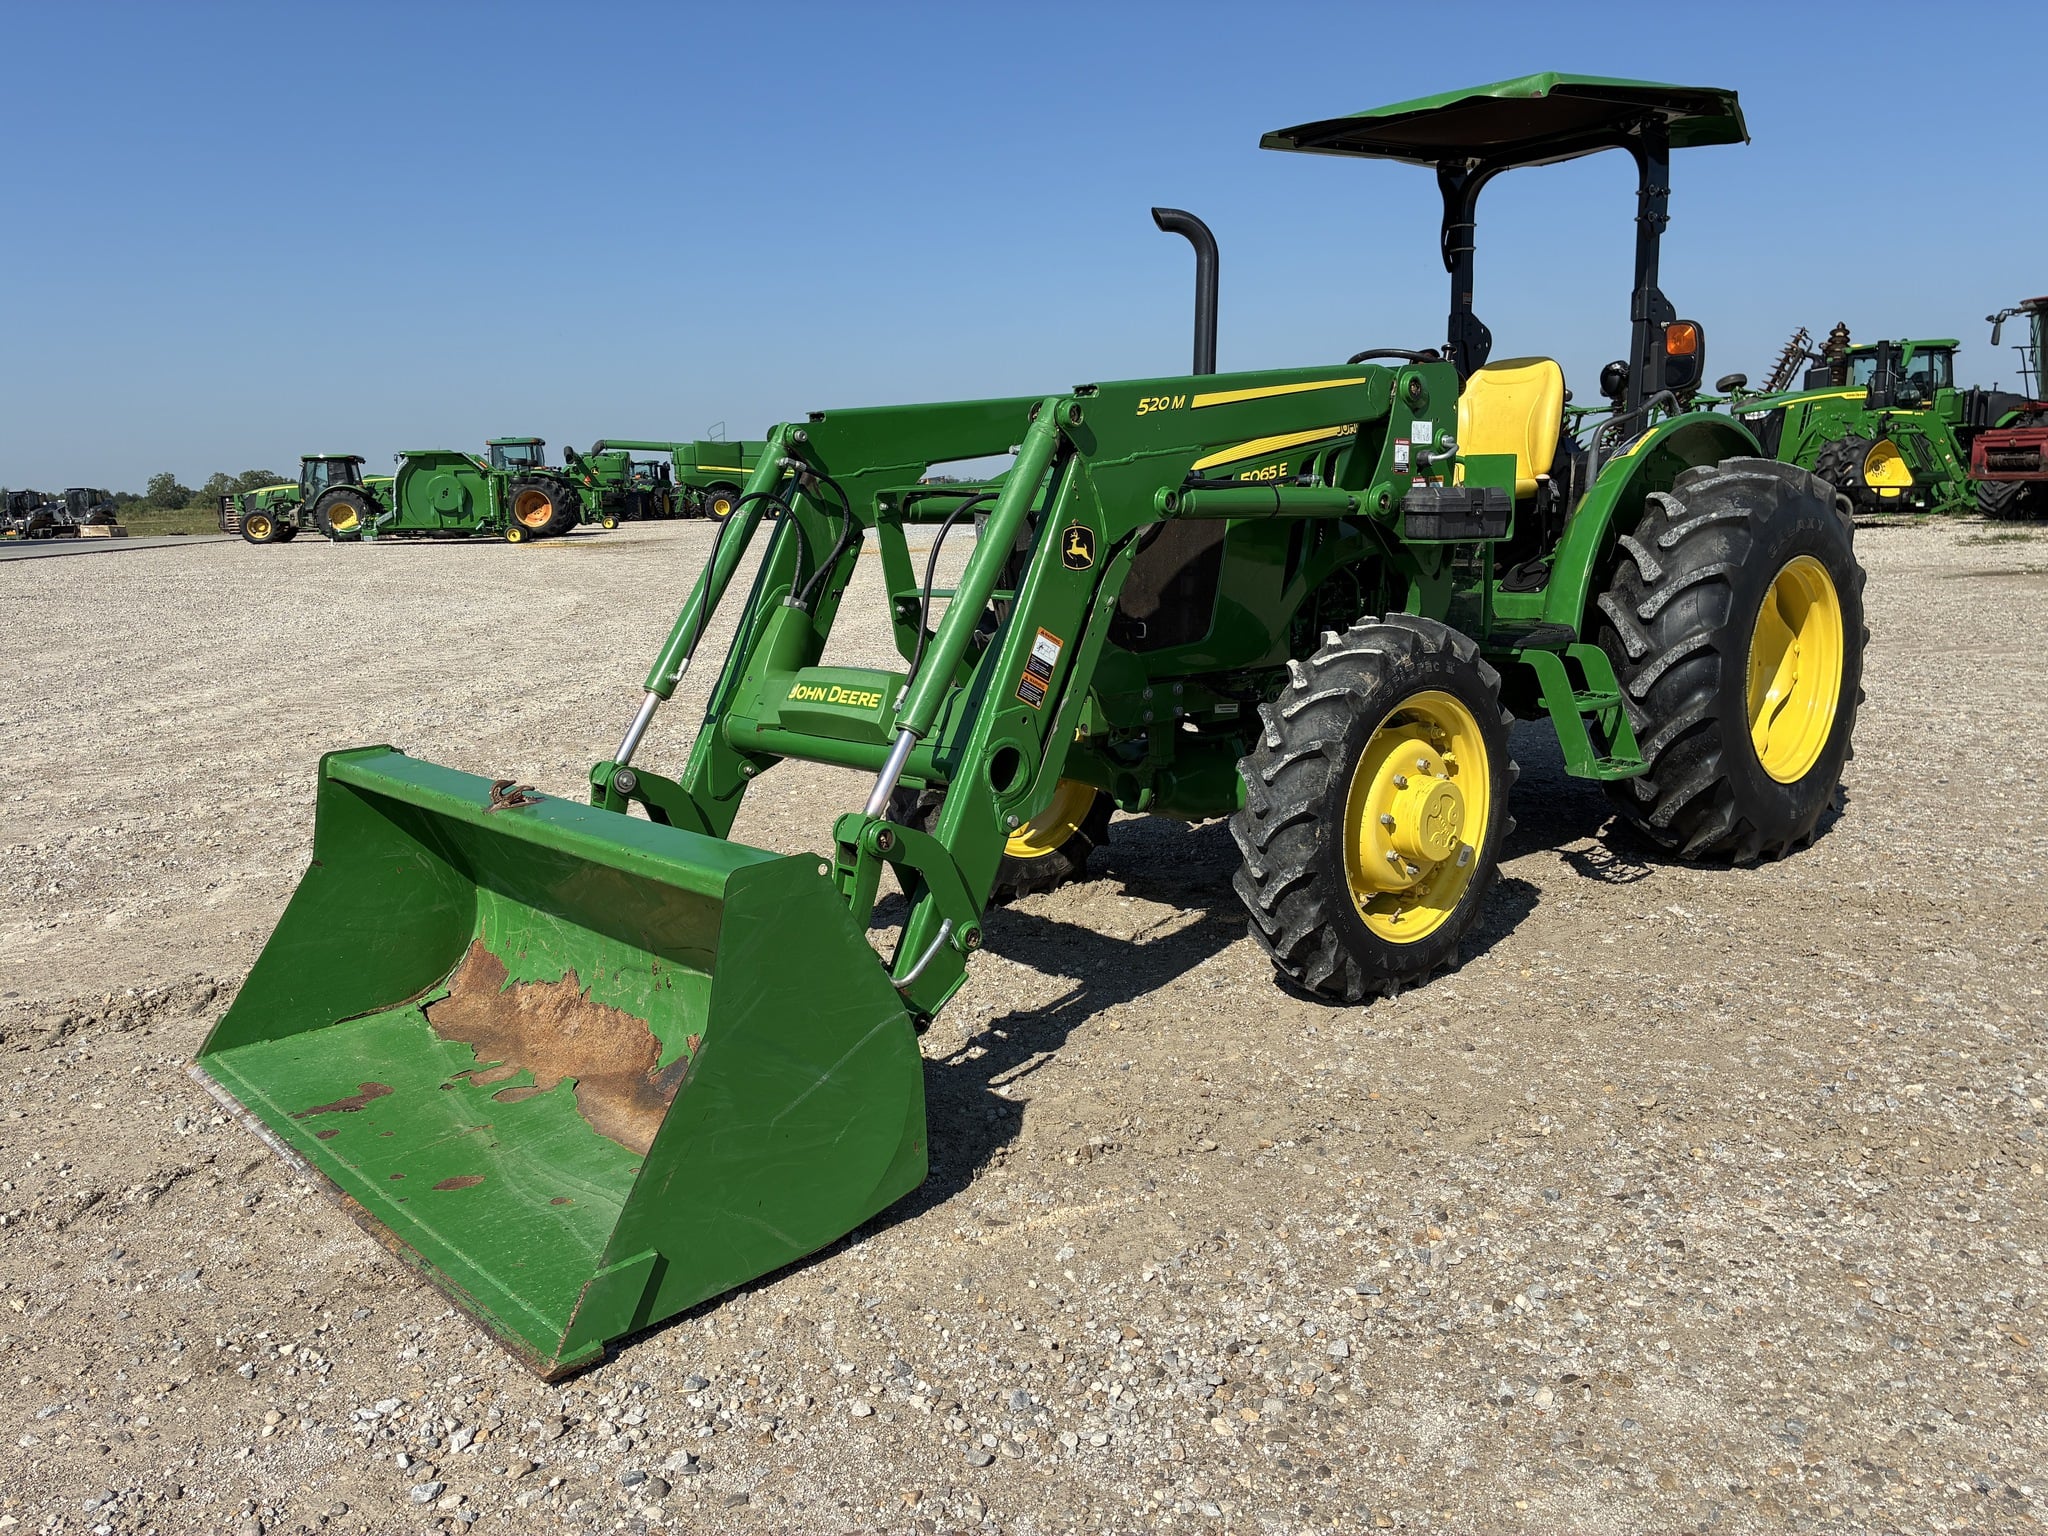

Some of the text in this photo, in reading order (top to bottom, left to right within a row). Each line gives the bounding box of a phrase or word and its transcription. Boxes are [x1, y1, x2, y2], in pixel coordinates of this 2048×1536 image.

[1136, 394, 1186, 416] 520 M
[1279, 462, 1288, 477] E
[788, 683, 882, 708] JOHN DEERE
